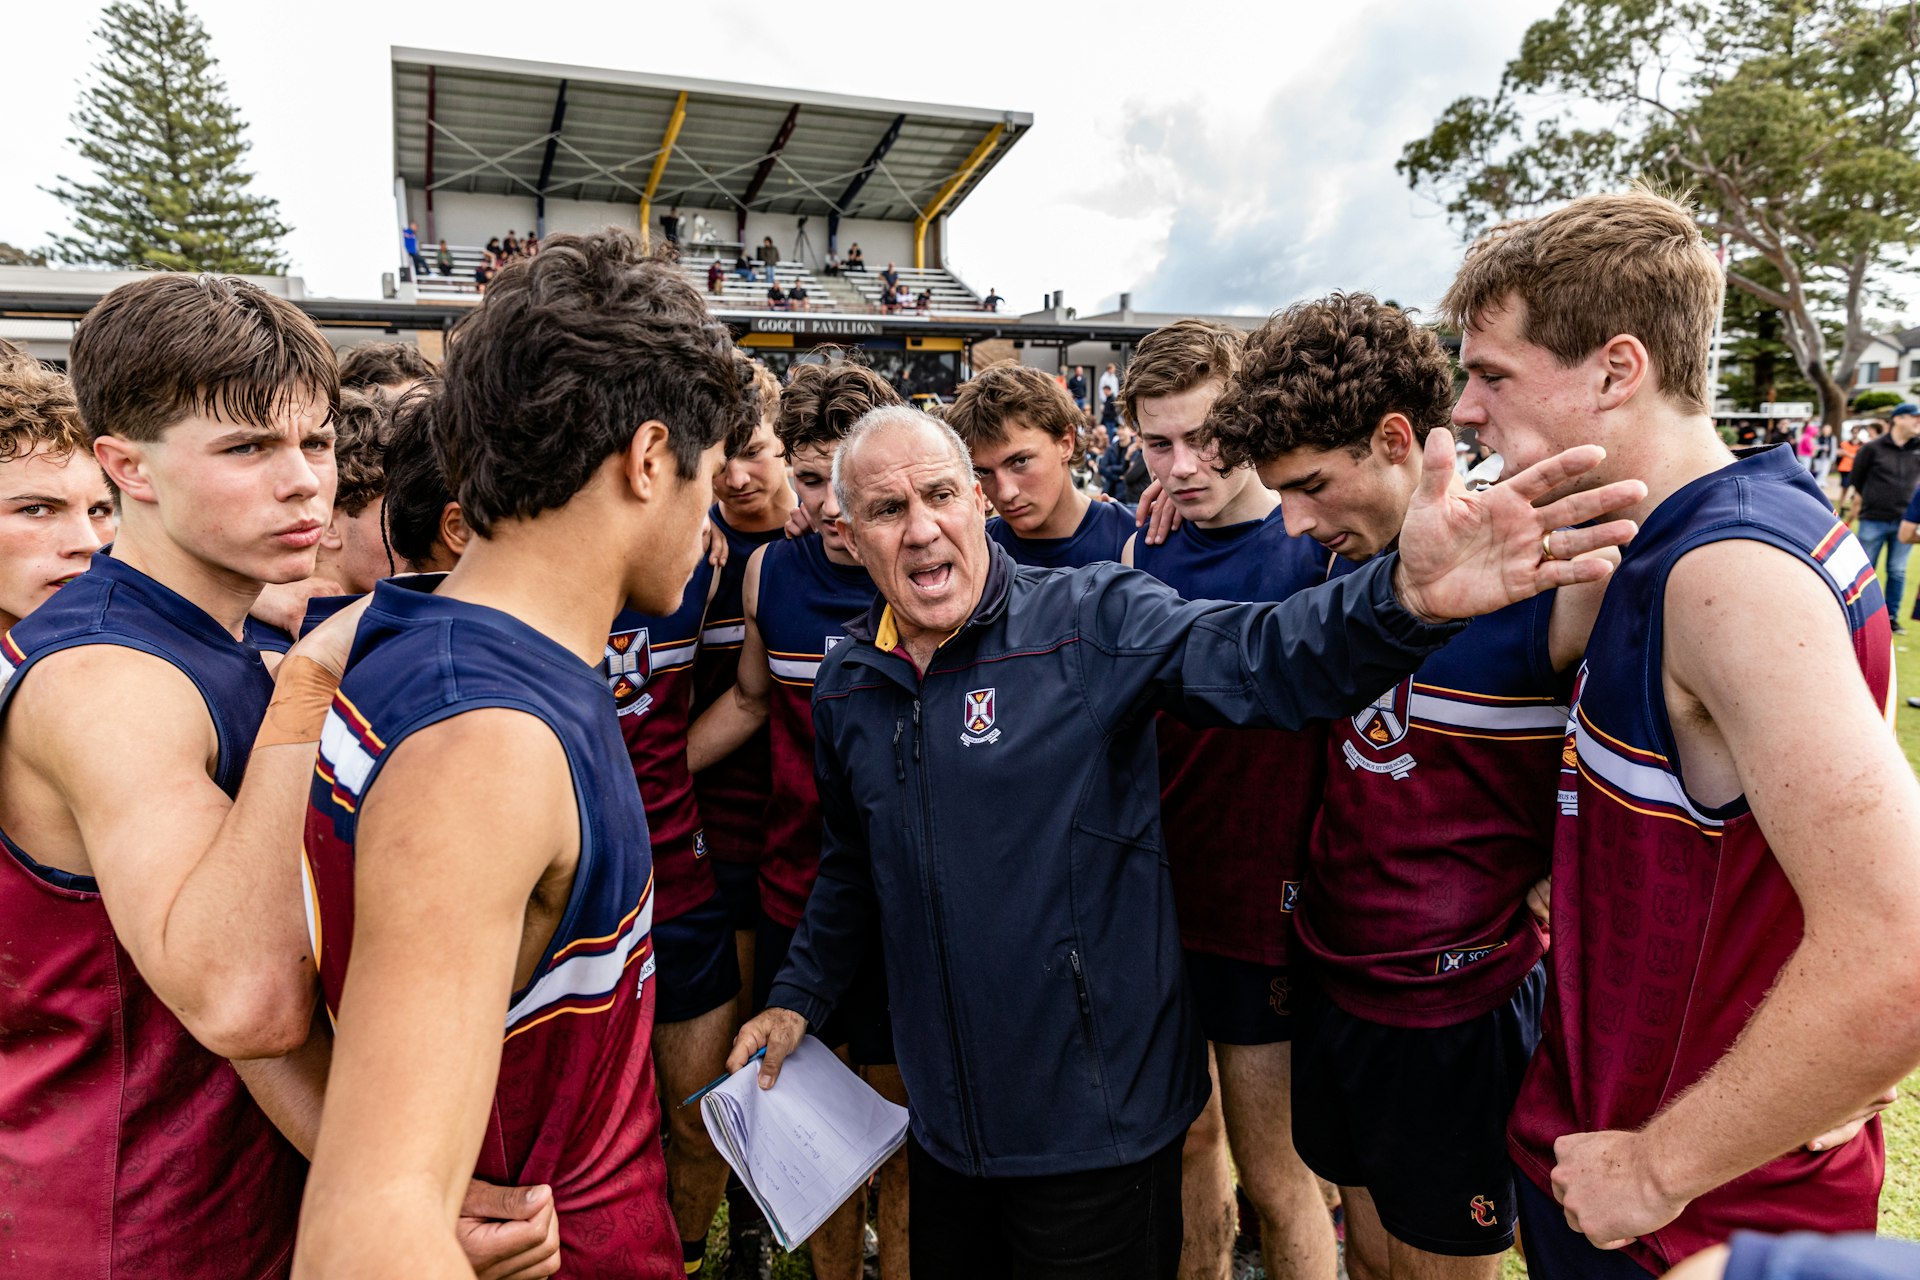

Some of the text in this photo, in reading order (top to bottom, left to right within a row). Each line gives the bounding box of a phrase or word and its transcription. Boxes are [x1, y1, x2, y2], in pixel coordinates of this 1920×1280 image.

[757, 319, 875, 334] GOOCH PAVILION
[1470, 1195, 1497, 1227] SC
